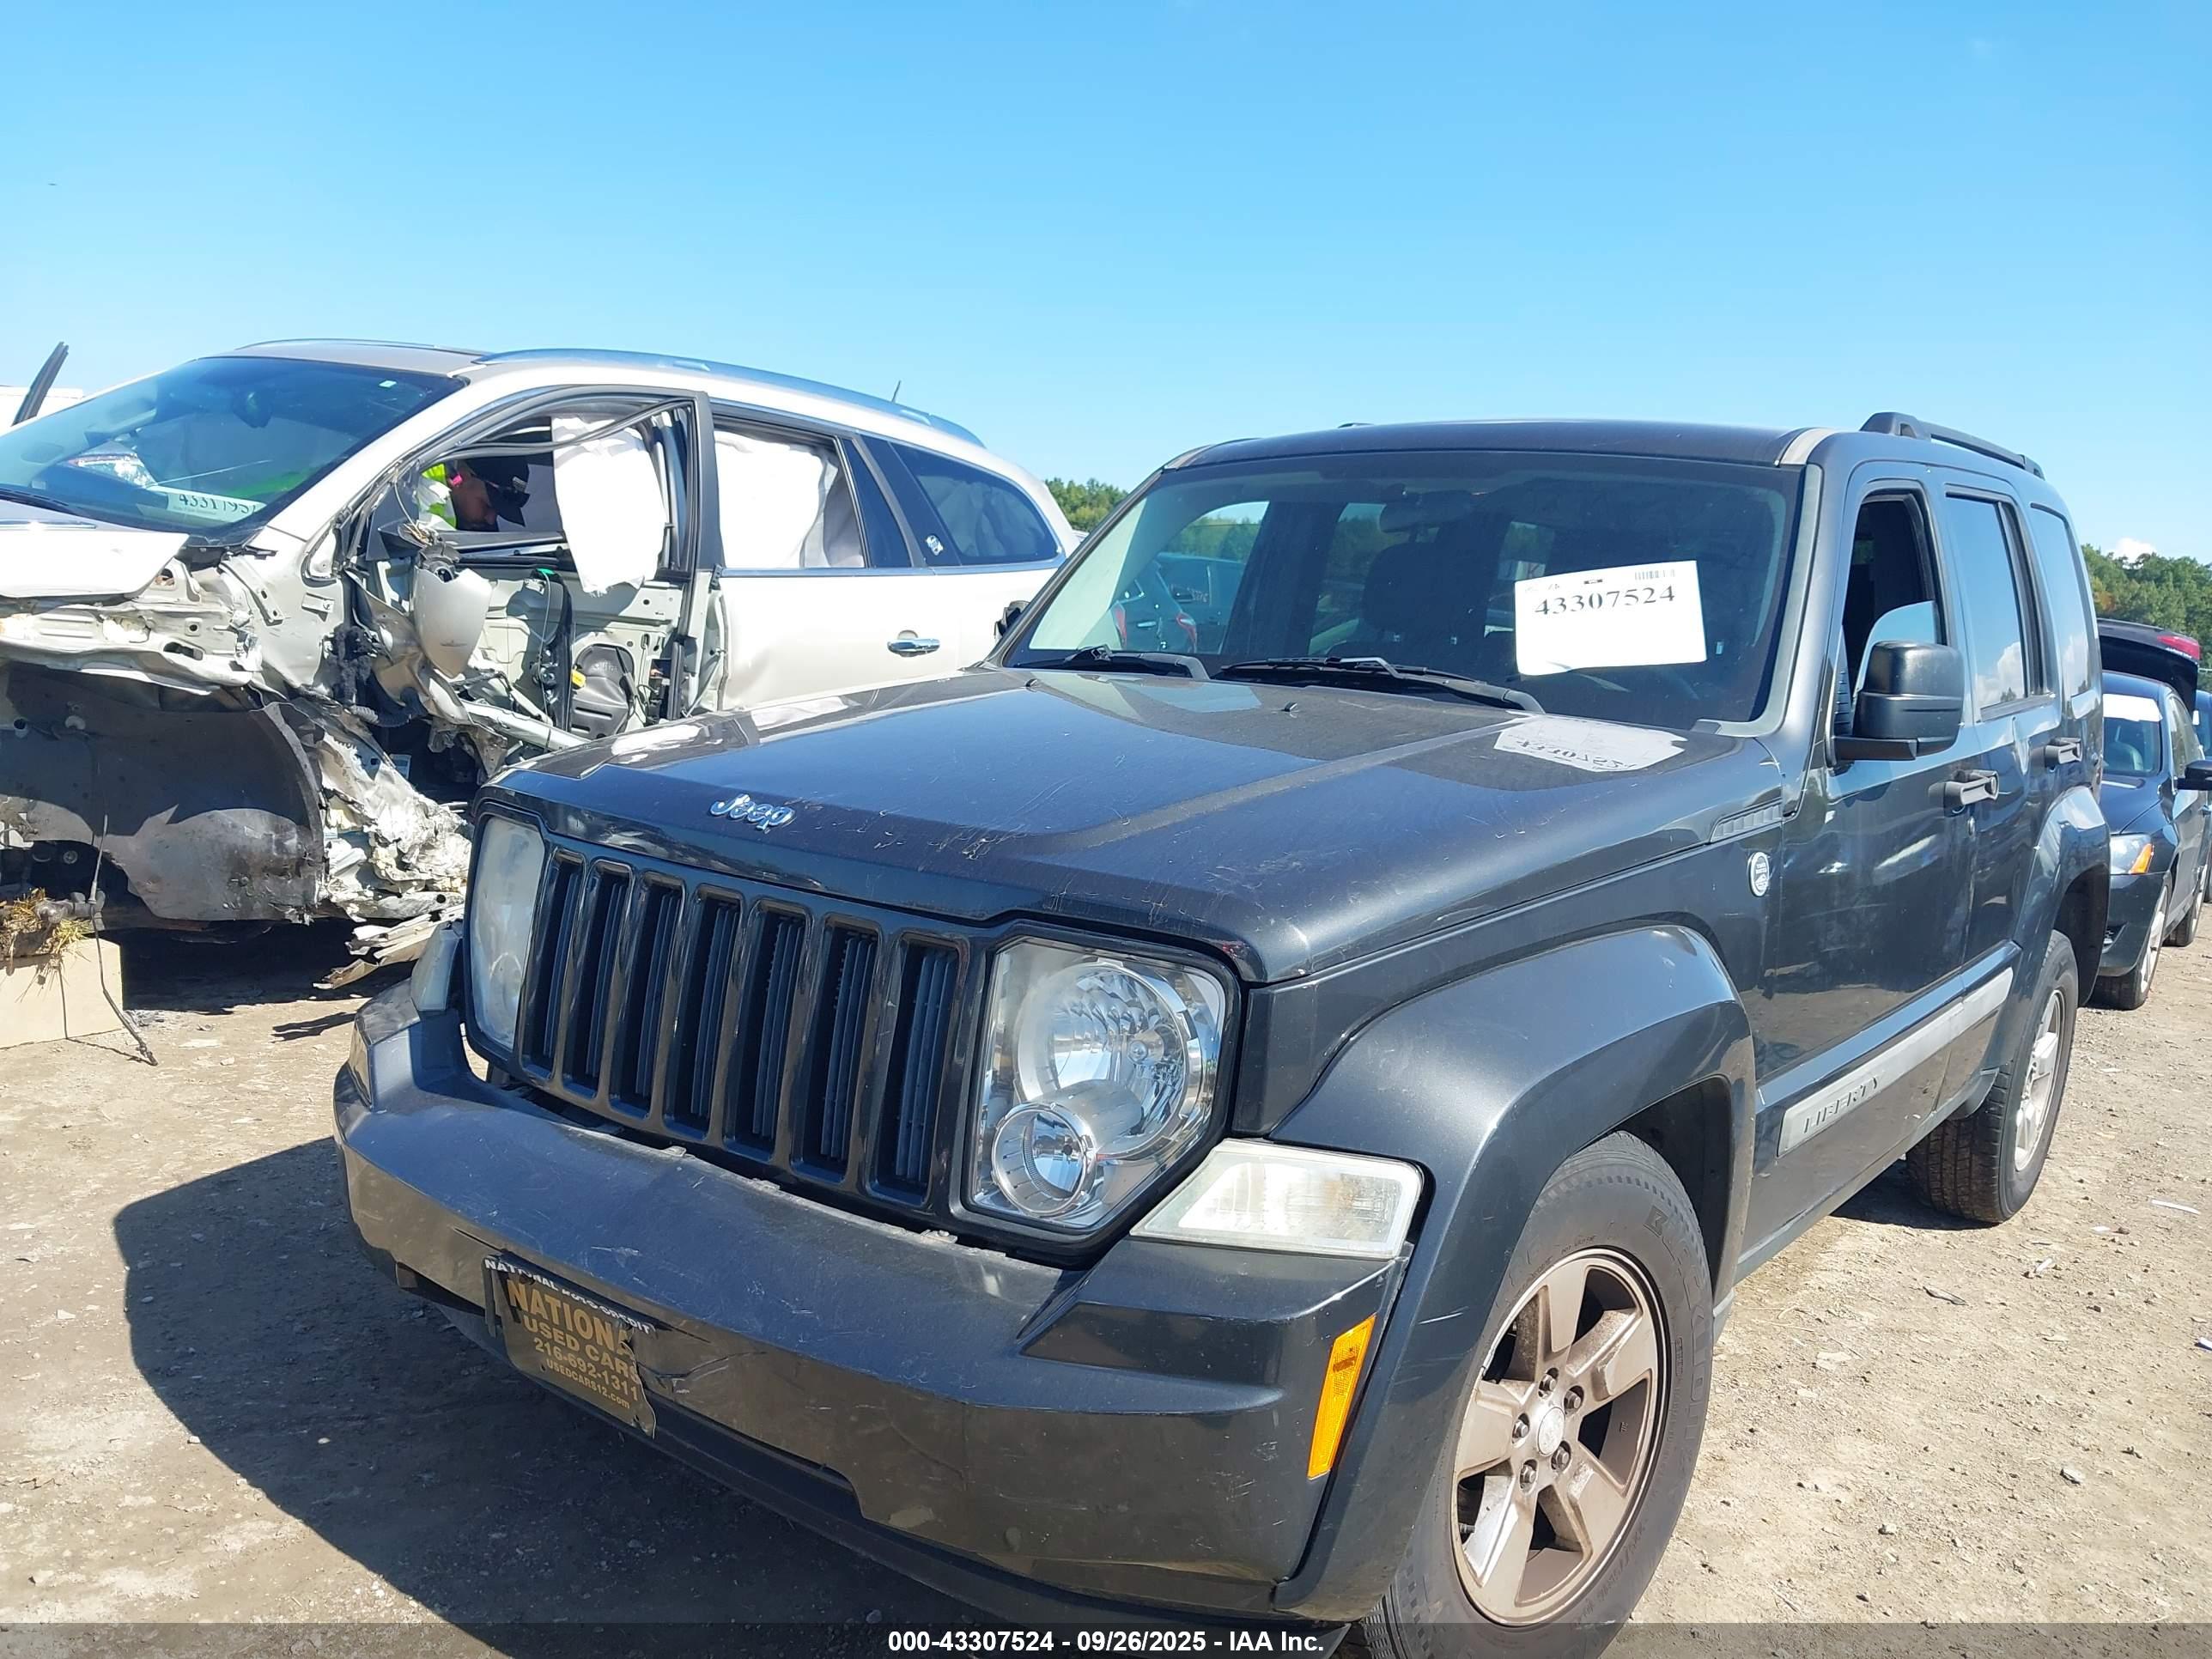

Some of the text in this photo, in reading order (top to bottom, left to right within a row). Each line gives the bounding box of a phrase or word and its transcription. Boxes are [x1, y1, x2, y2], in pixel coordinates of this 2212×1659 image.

[1534, 585, 1675, 616] 43307524
[709, 793, 795, 830] Jeep
[1803, 1077, 1878, 1133] LIBERTY
[507, 1278, 633, 1358] NATIONA
[523, 1314, 641, 1385] USED CARS
[533, 1337, 638, 1401] 216-692-1311
